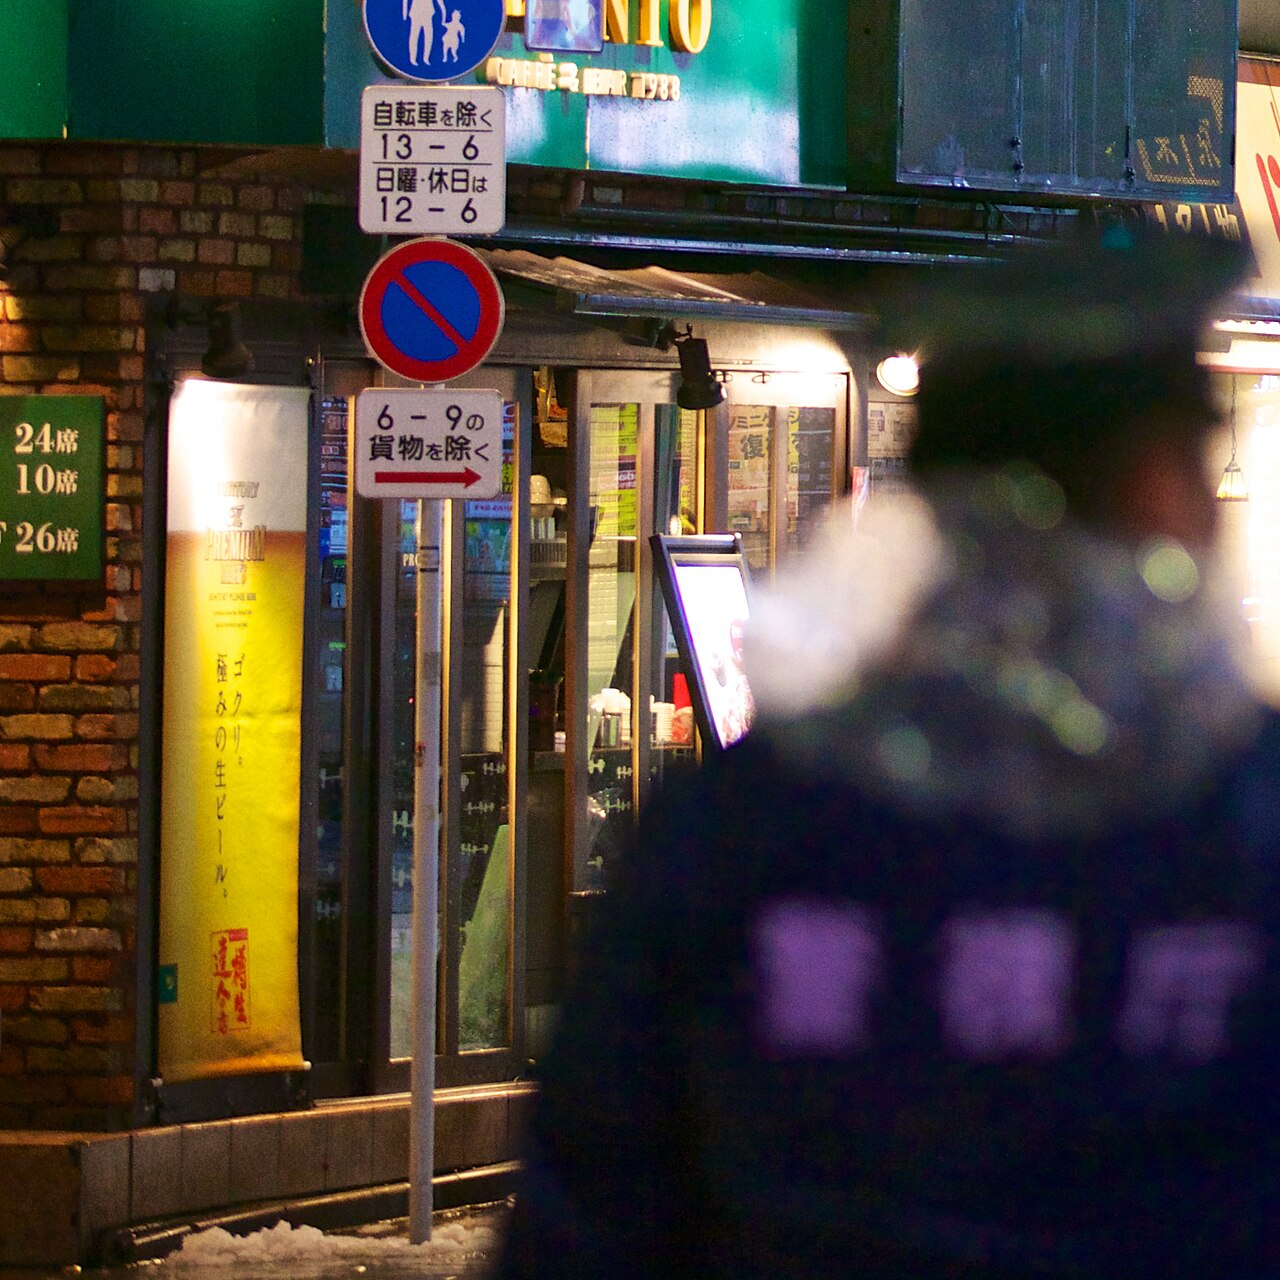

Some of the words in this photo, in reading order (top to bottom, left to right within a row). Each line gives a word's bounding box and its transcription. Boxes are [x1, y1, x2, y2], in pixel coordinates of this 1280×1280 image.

[630, 72, 681, 102] 1988
[374, 100, 492, 128] 自転車を除く
[381, 133, 412, 160] 13
[462, 135, 479, 160] 6
[376, 167, 488, 194] 日曜・休日は
[380, 196, 412, 222] 12
[461, 198, 477, 223] 6
[377, 404, 394, 430] 6
[14, 422, 80, 455] 24席
[369, 434, 489, 461] 貨物を除く
[16, 463, 79, 496] 10席
[14, 521, 80, 556] 26席
